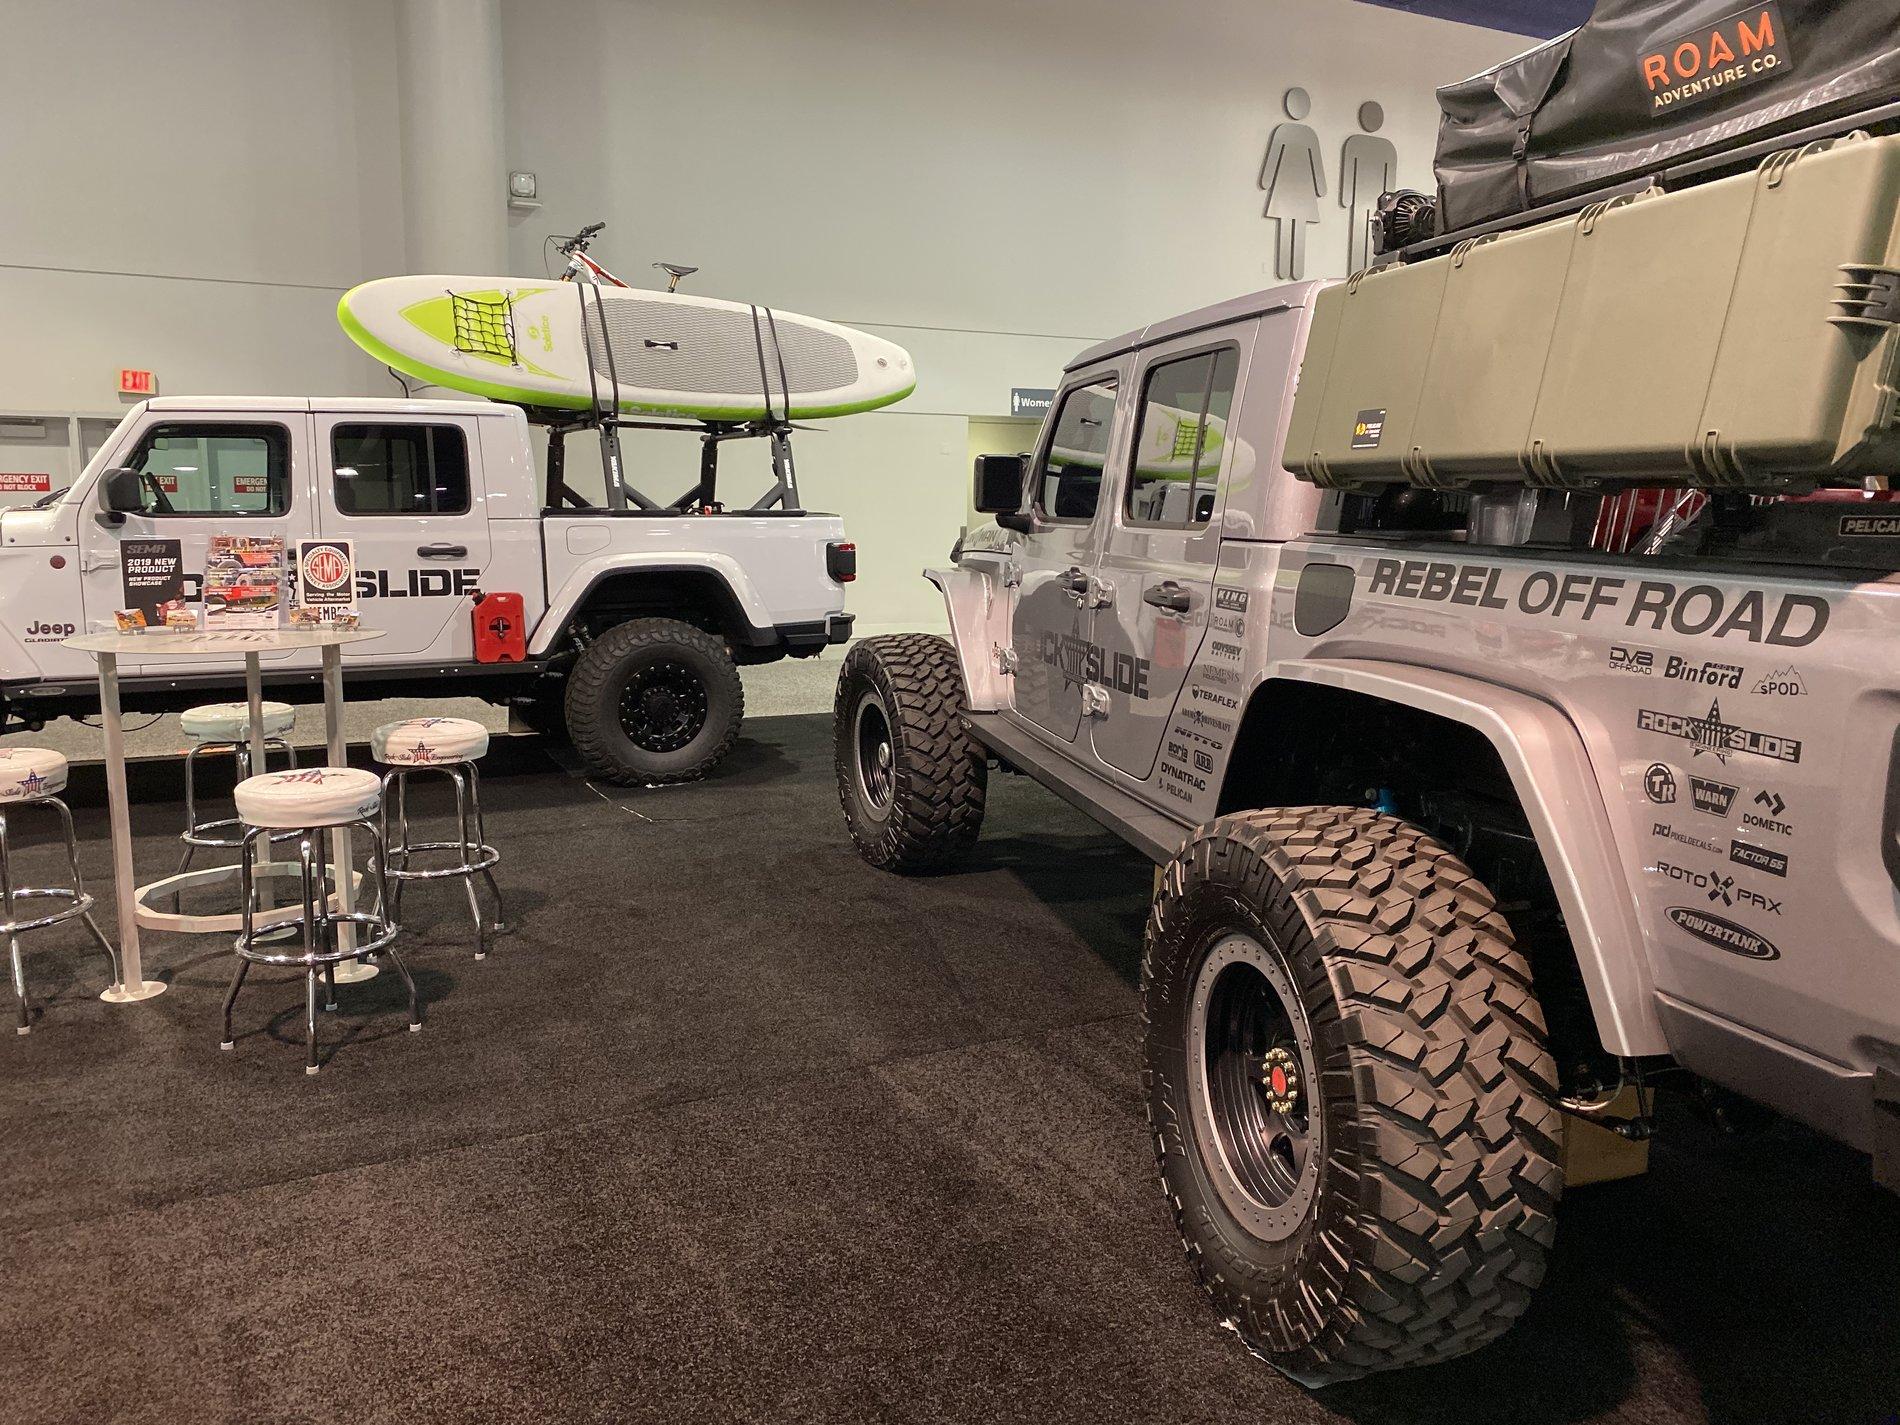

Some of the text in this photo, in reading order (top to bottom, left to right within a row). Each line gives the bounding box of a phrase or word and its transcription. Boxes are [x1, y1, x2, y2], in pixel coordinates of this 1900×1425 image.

[1643, 11, 1775, 91] ROAM
[1654, 54, 1782, 108] ADVENTURE CO.
[122, 370, 150, 390] EXIT
[30, 475, 48, 484] EXIT
[160, 476, 175, 485] EXIT
[1845, 519, 1900, 533] PELICA
[127, 544, 166, 553] SEMA
[127, 557, 177, 566] 2019 NEW
[311, 552, 342, 583] SEMA
[355, 569, 480, 598] SLIDE
[1217, 590, 1247, 603] KING
[1368, 558, 1831, 649] REBEL OFF ROAD
[26, 620, 76, 636] Jeep
[1211, 641, 1242, 656] ODYSSEY
[1211, 650, 1241, 661] BATTERY
[1086, 644, 1150, 700] SLIDE
[1203, 664, 1240, 682] NEMESIS
[1664, 655, 1745, 690] Binford
[1760, 681, 1800, 696] sPOD
[1200, 689, 1238, 710] TERAFLEX
[1174, 726, 1223, 750] NITTO
[1640, 711, 1798, 761] ROCK SLIDE
[1195, 753, 1212, 771] ARB
[1160, 761, 1206, 792] DYNATRAC
[1166, 782, 1193, 804] PELICAN
[1695, 788, 1728, 807] WARN
[1742, 813, 1793, 836] DOMETIC
[1732, 847, 1770, 866] FACTOR
[1657, 860, 1708, 888] ROTO
